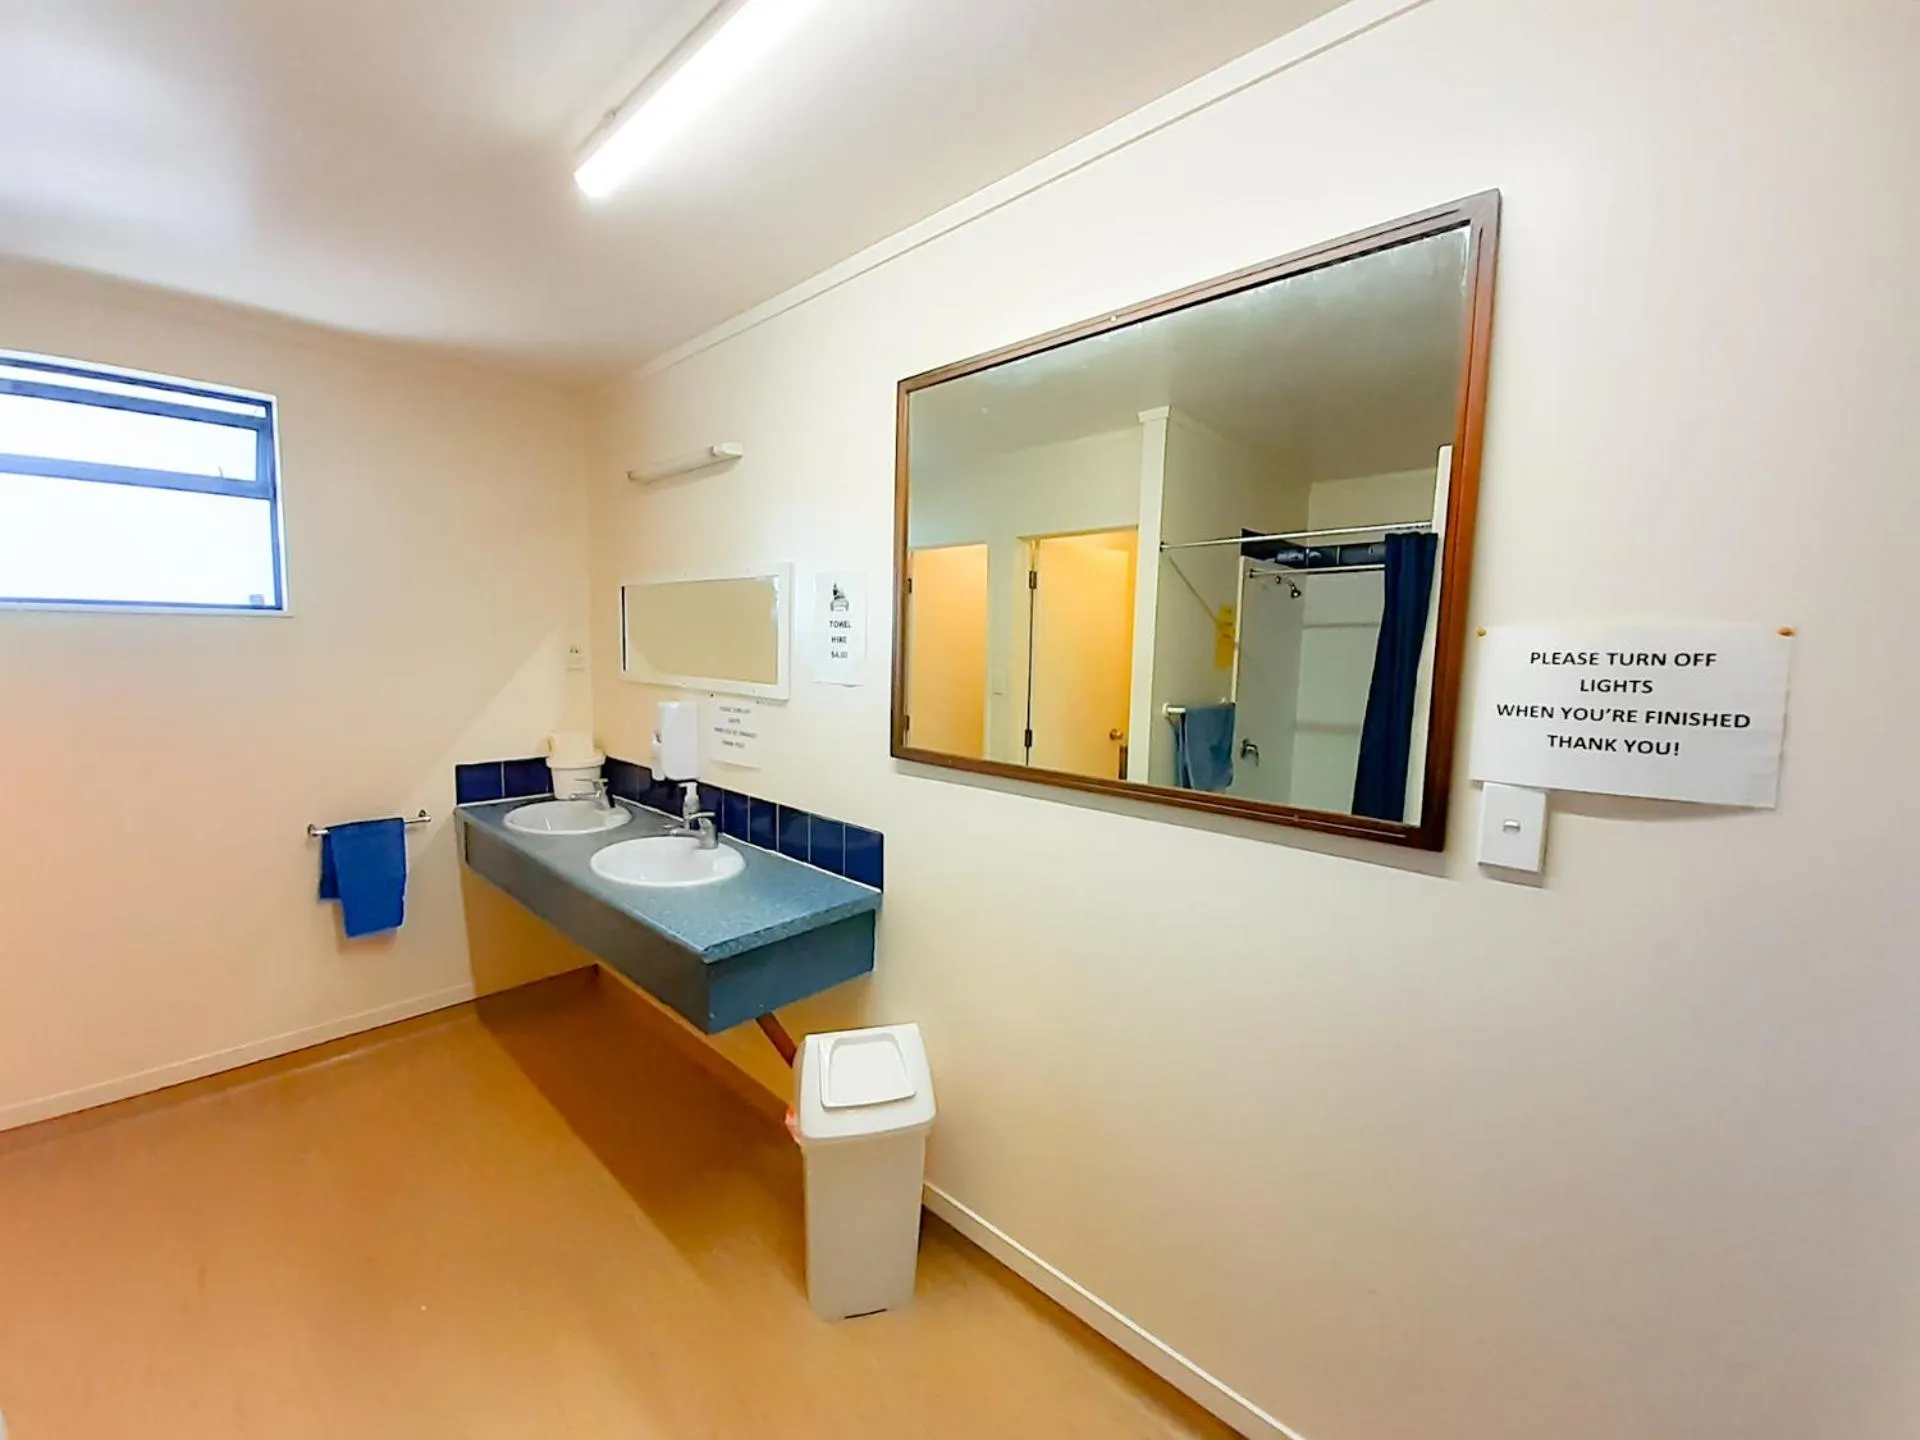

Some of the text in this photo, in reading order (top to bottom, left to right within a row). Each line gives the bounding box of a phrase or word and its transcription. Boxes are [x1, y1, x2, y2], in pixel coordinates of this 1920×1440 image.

[1529, 651, 1718, 668] PLEASE TURN OFF
[1579, 678, 1654, 694] LIGHTS
[1496, 703, 1751, 728] WHEN YOU'RE FINISHED
[1547, 734, 1680, 757] THANK YOU!
